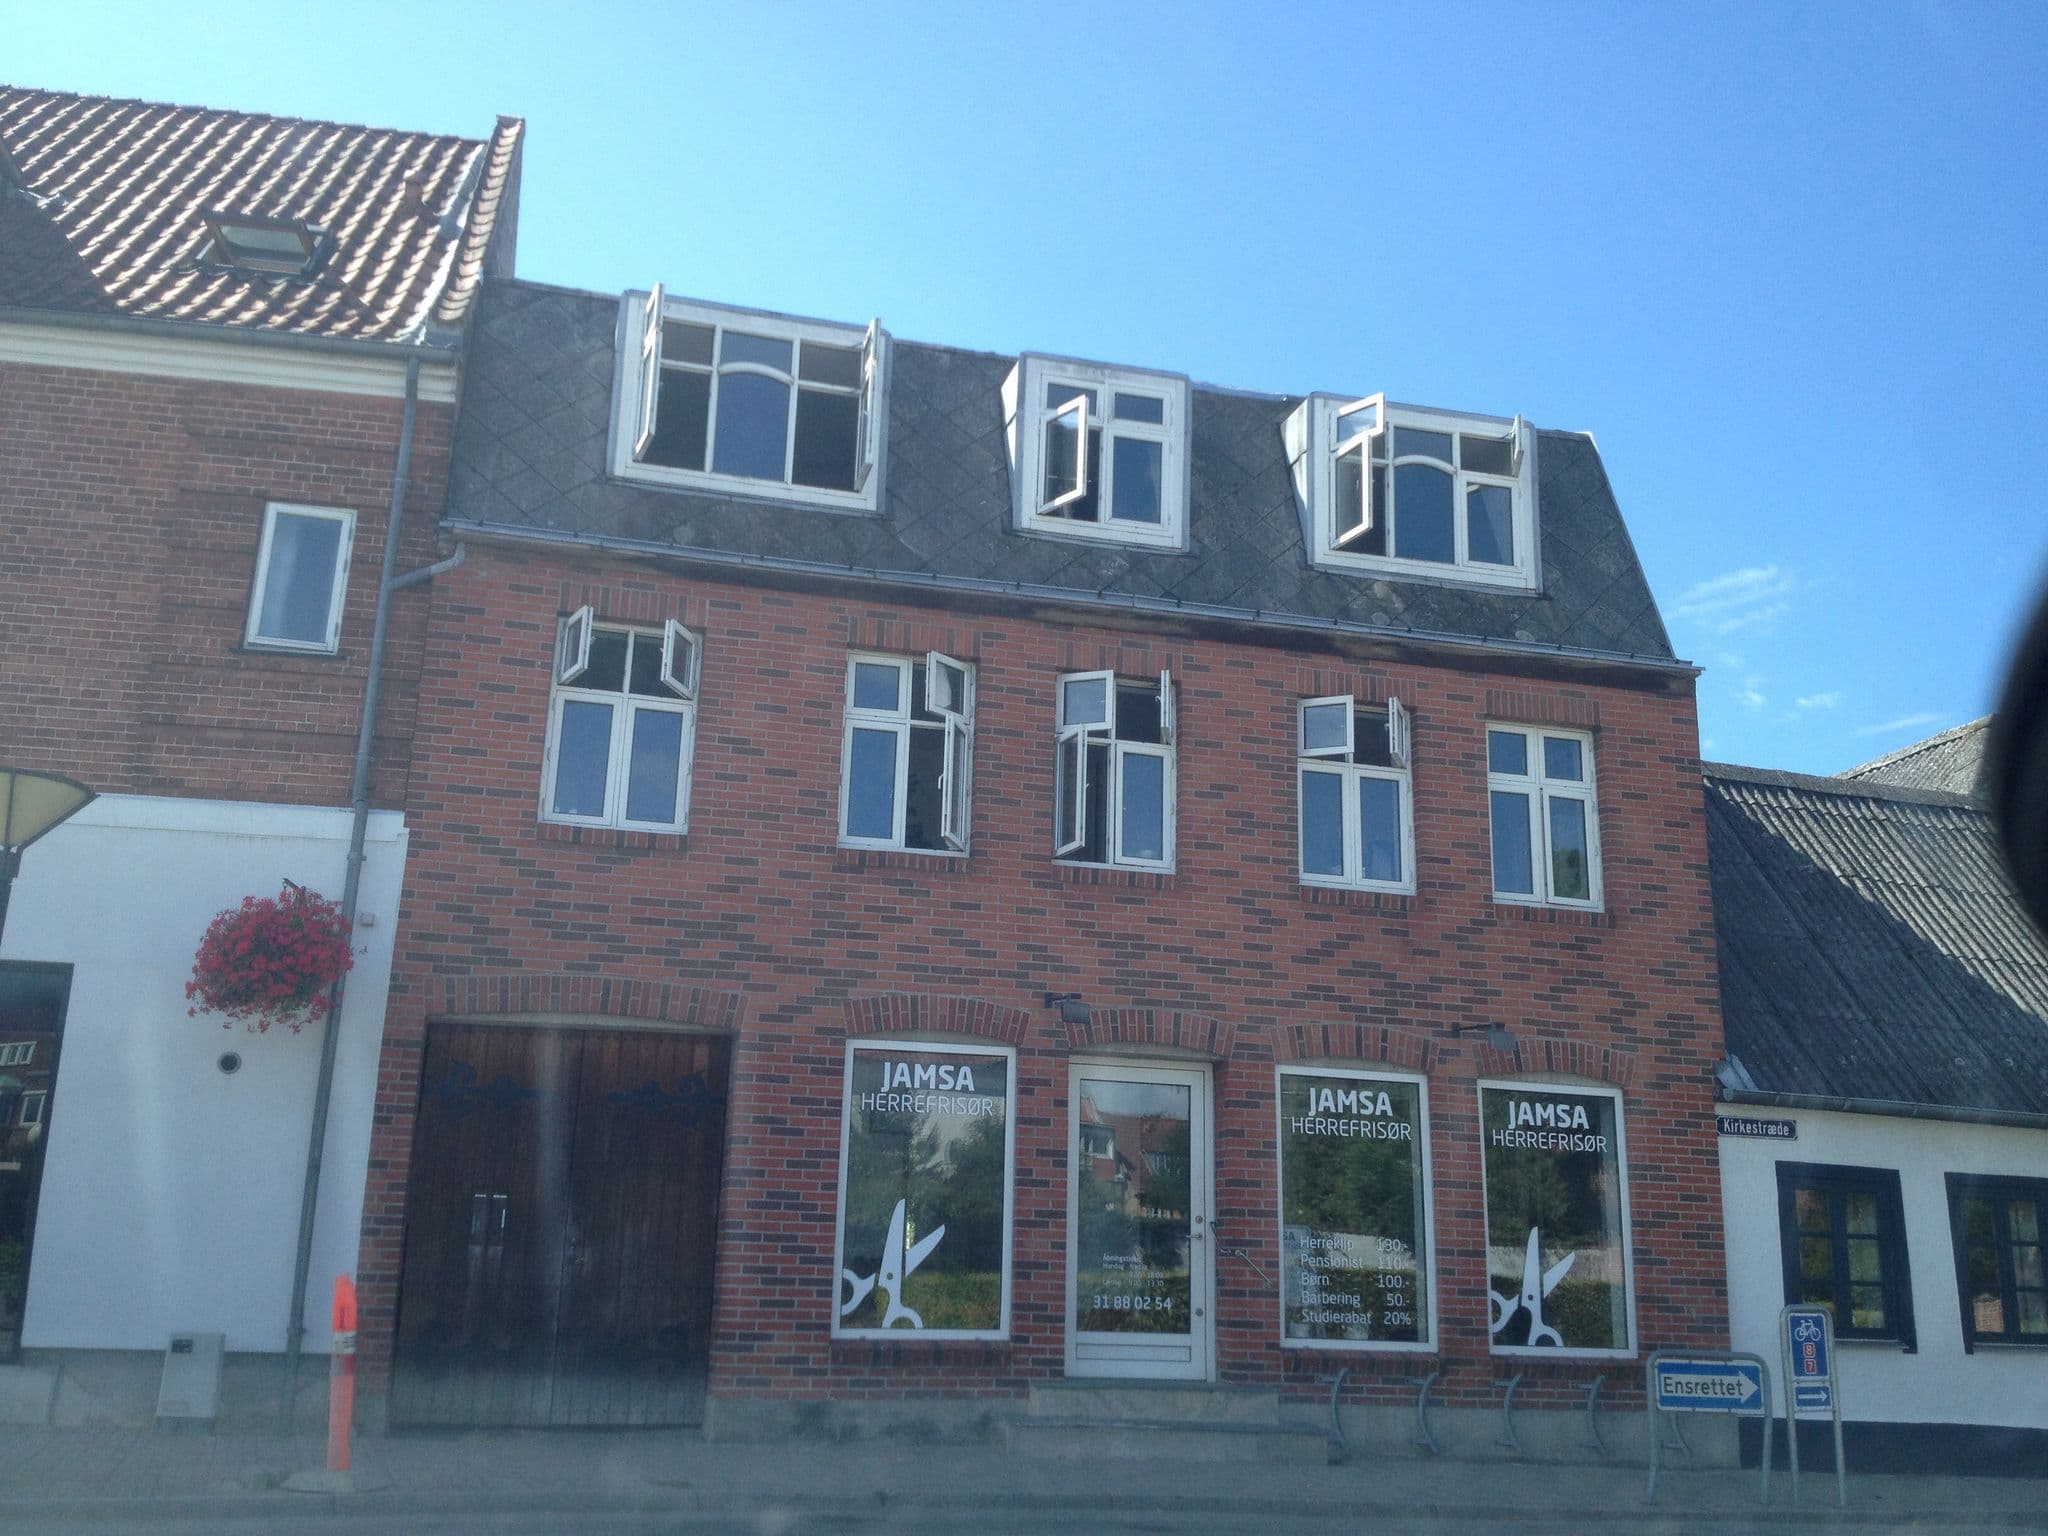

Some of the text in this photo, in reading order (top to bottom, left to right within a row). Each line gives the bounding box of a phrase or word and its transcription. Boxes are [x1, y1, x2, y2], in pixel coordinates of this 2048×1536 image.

[880, 1062, 975, 1092] JAMSA
[861, 1092, 993, 1116] HERREFRISØR
[1308, 1087, 1393, 1116] JAMSA
[1508, 1101, 1589, 1129] JAMSA
[1291, 1116, 1411, 1140] HERREFRISØR
[1723, 1118, 1789, 1136] Kirkestræde
[1492, 1129, 1607, 1152] HERREFRISØR
[1300, 1236, 1354, 1250] Herreklip
[1301, 1254, 1363, 1269] Pensionist
[1301, 1272, 1409, 1288] Børn 100.-
[1093, 1295, 1171, 1310] 31 88 02 54
[1302, 1291, 1410, 1308] Barbering 50.-
[1302, 1309, 1412, 1325] Studierabat 20%
[1806, 1345, 1813, 1355] 8
[1807, 1361, 1813, 1371] 7
[1663, 1376, 1744, 1396] Ensrettet
